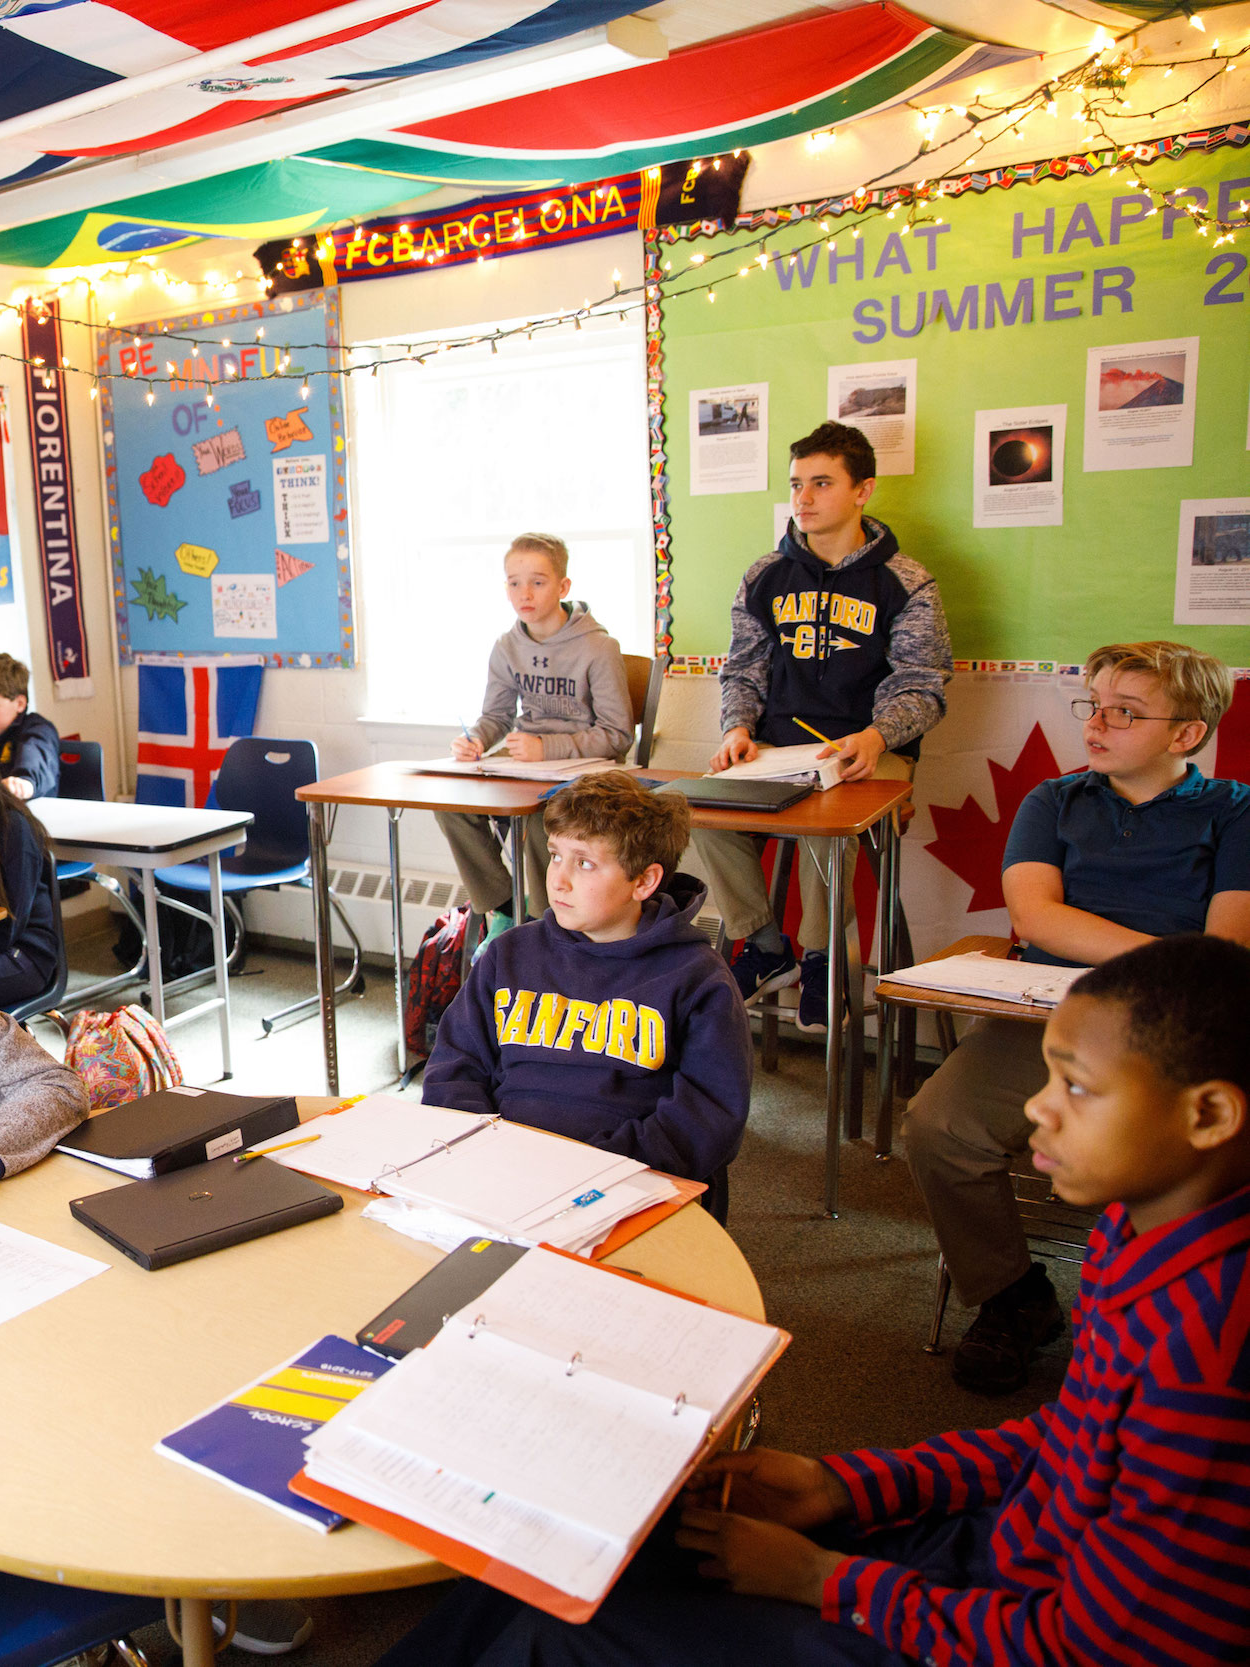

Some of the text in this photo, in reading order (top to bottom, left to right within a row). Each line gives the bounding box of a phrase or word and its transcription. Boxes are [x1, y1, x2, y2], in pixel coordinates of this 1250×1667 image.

[1012, 177, 1250, 259] HAPPE
[772, 223, 951, 292] WHAT
[851, 265, 1136, 344] SUMMER
[119, 342, 157, 379] BE
[32, 368, 73, 607] FIORENTINA
[772, 590, 878, 636] SANFORD
[514, 672, 576, 697] ANFORD
[493, 987, 667, 1071] SANFORD
[249, 1410, 313, 1431] SCHOOL
